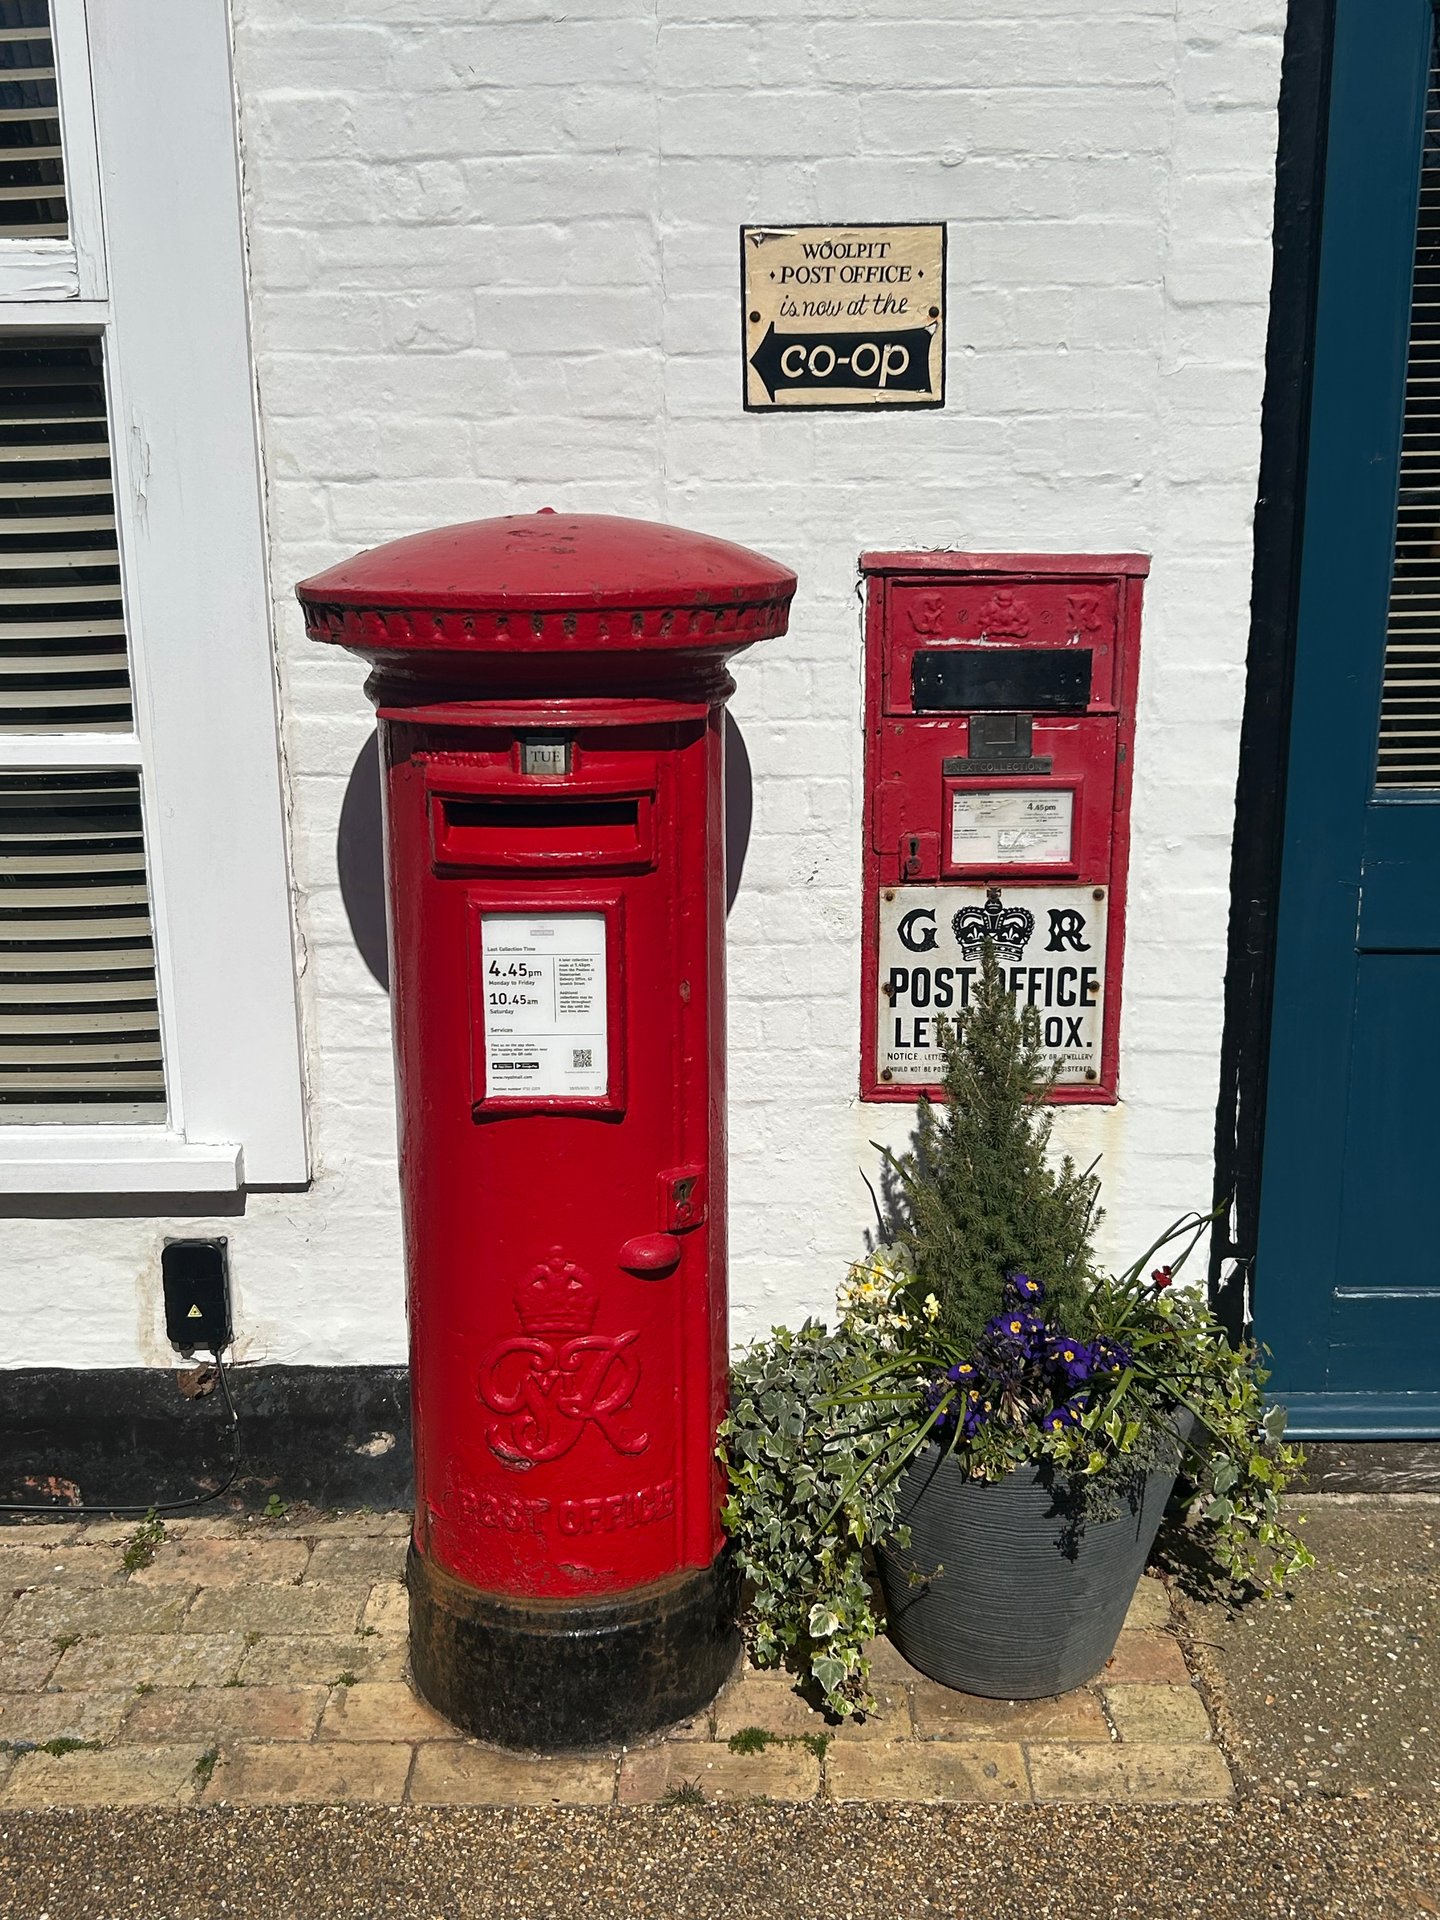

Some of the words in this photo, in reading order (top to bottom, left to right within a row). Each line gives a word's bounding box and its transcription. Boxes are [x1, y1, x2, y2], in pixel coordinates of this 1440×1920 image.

[800, 242, 891, 259] WOOLPIT
[778, 265, 836, 284] POST
[840, 265, 912, 283] OFFICE
[780, 294, 799, 317] is
[803, 300, 844, 317] now
[847, 293, 869, 315] at
[873, 292, 909, 314] the
[530, 750, 562, 763] TUE
[952, 762, 978, 772] NEXT
[980, 761, 1042, 771] COLLECTION
[897, 908, 939, 953] G
[1044, 908, 1091, 952] R
[488, 960, 542, 978] 4.45pm
[889, 967, 976, 1008] POST
[489, 992, 539, 1005] 10.45am
[459, 1487, 551, 1535] POST
[557, 1480, 674, 1537] OFFICE
